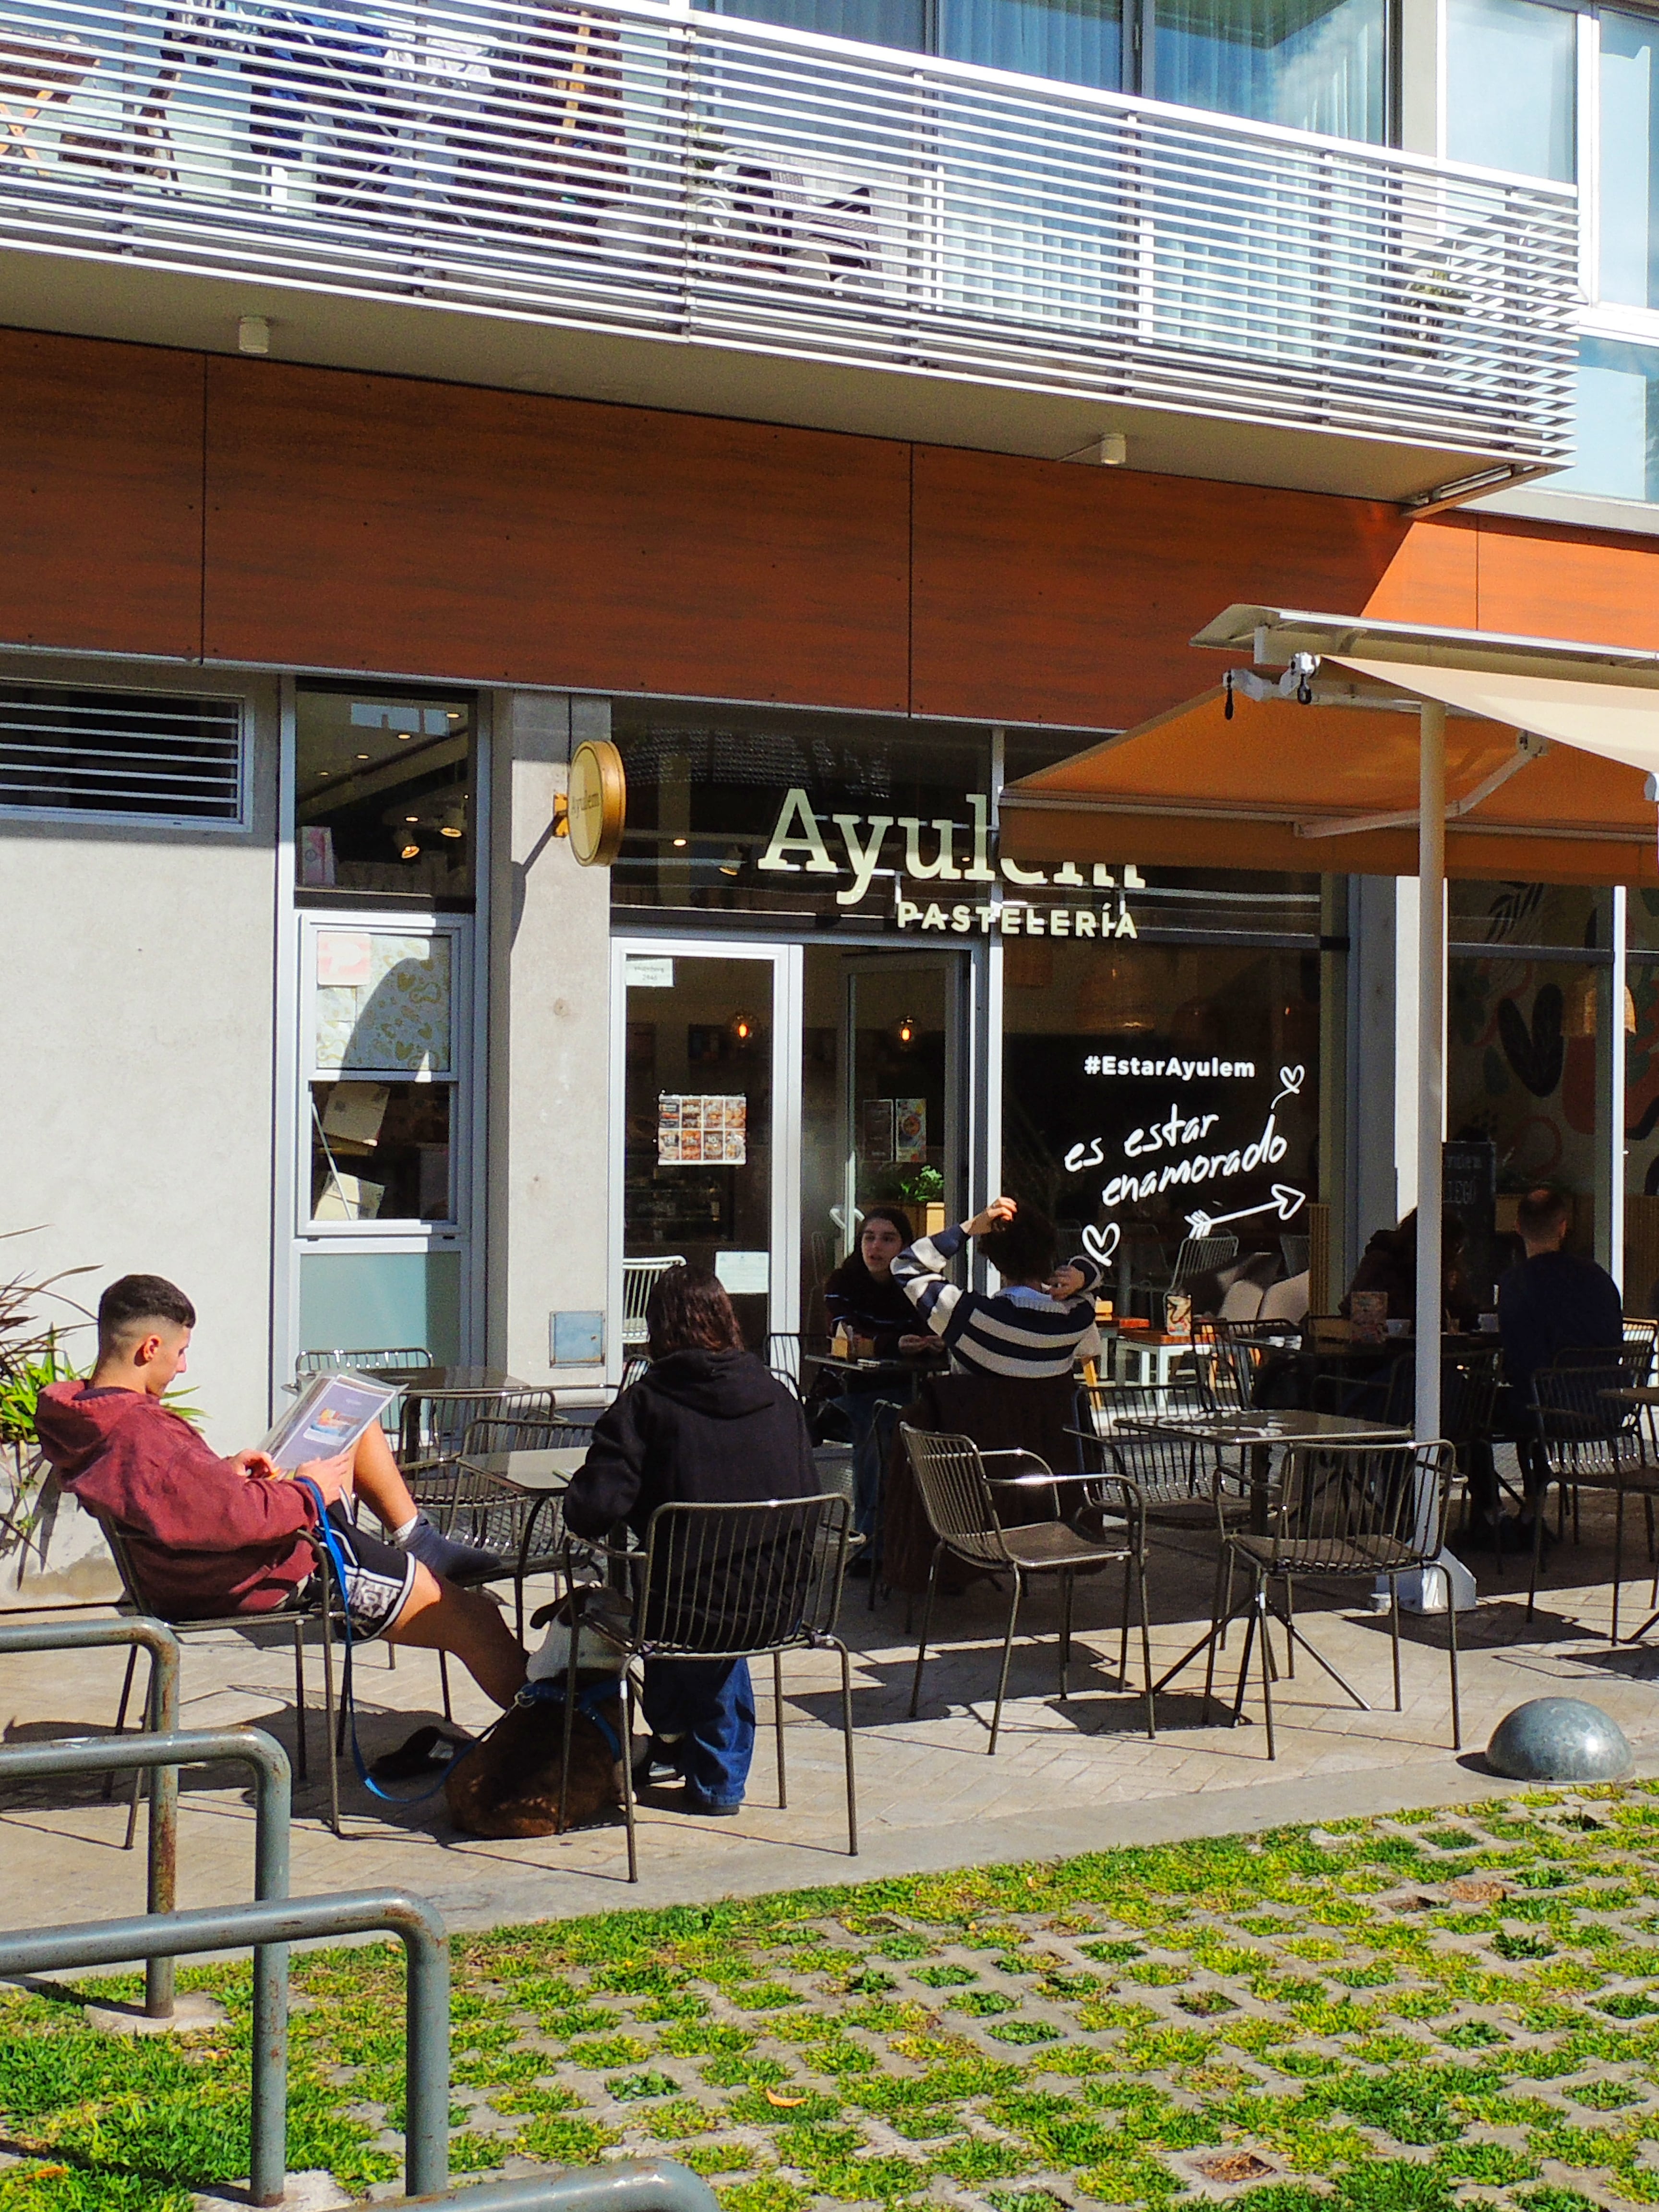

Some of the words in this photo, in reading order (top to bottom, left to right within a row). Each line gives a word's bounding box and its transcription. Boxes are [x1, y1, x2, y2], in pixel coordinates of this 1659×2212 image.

[897, 901, 1138, 939] PASTELERÍA
[1084, 1056, 1255, 1081] #EstarAyulem
[1064, 1138, 1104, 1172] es
[1124, 1104, 1219, 1157] estar
[1102, 1114, 1287, 1207] enamorado
